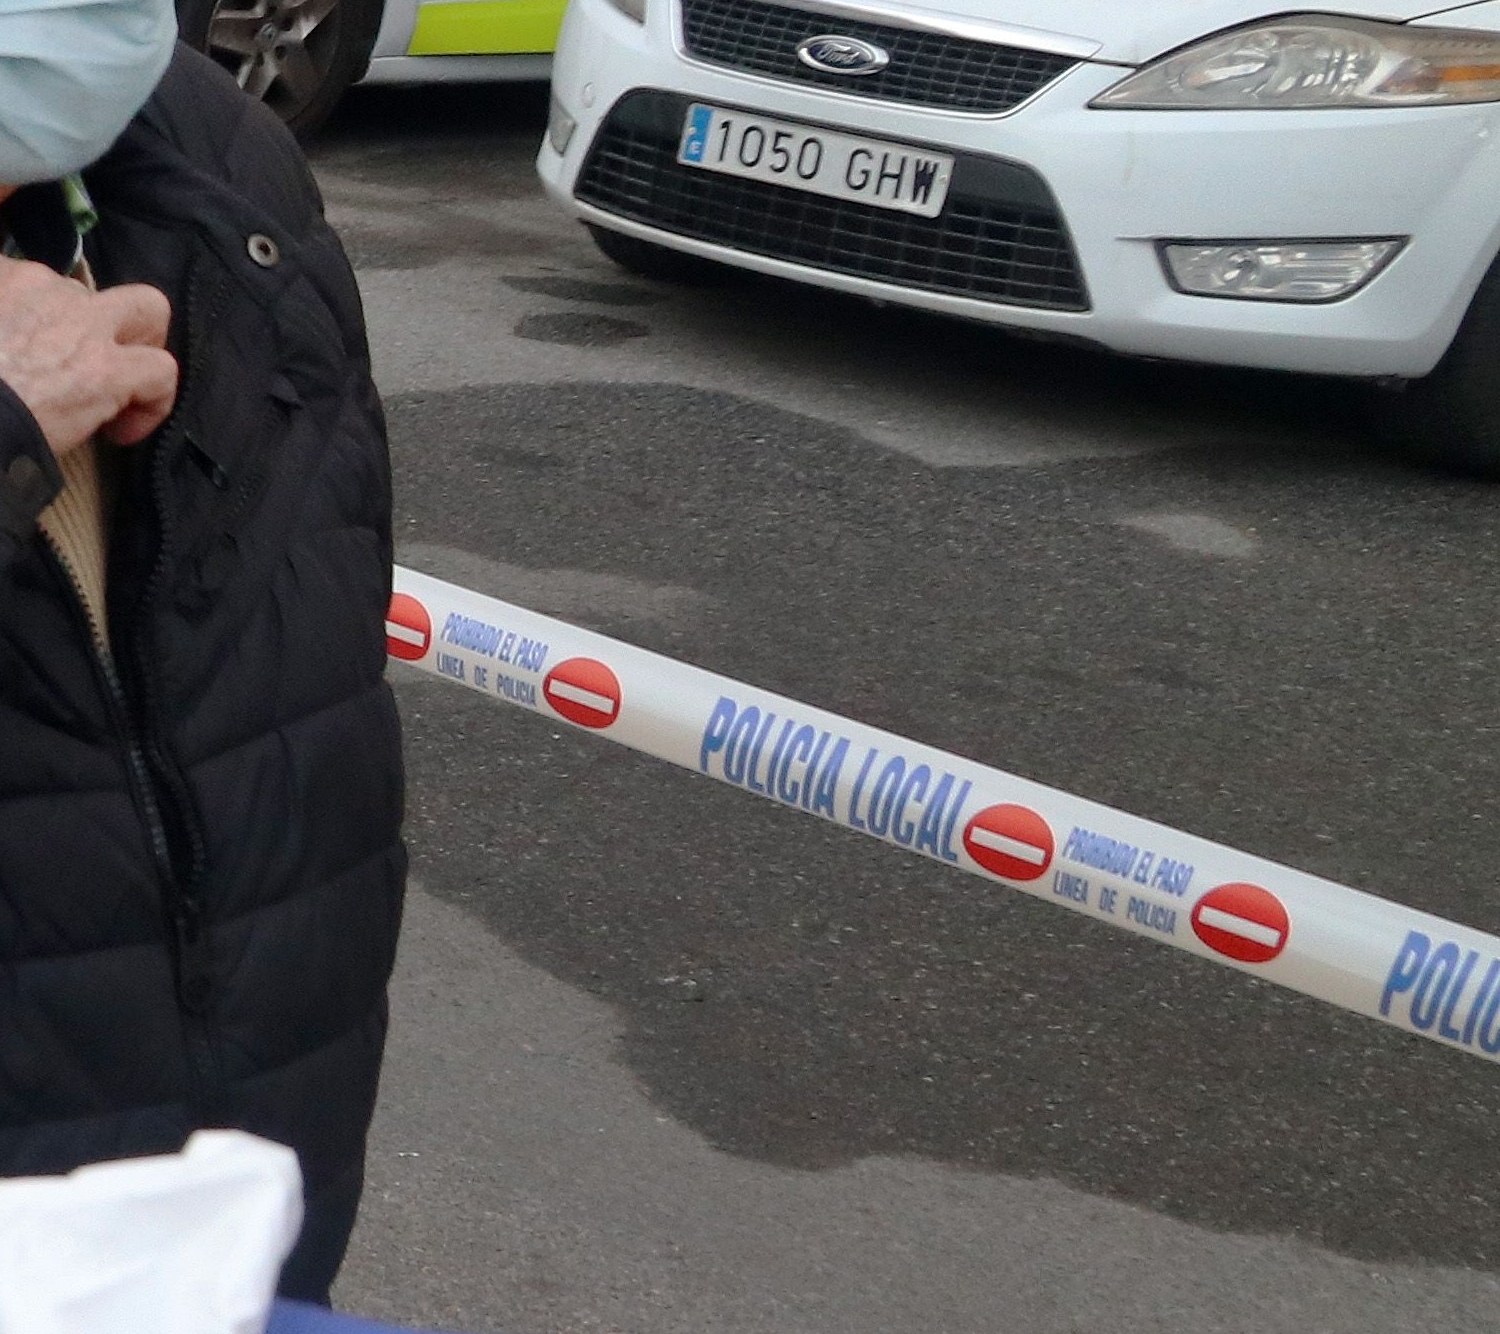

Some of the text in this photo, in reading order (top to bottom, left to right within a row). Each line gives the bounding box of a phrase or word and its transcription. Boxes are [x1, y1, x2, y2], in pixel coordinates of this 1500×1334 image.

[817, 42, 861, 66] Ford
[718, 119, 939, 205] 1050 GHW
[441, 612, 550, 673] PROHIBIDO EL PASO
[436, 651, 537, 708] LINEA DE POLICIA
[700, 696, 973, 863] POLICIA LOCAL
[1062, 826, 1195, 898] PROHIBIDO EL PASO
[1053, 869, 1177, 936] LINEA DE POLICIA
